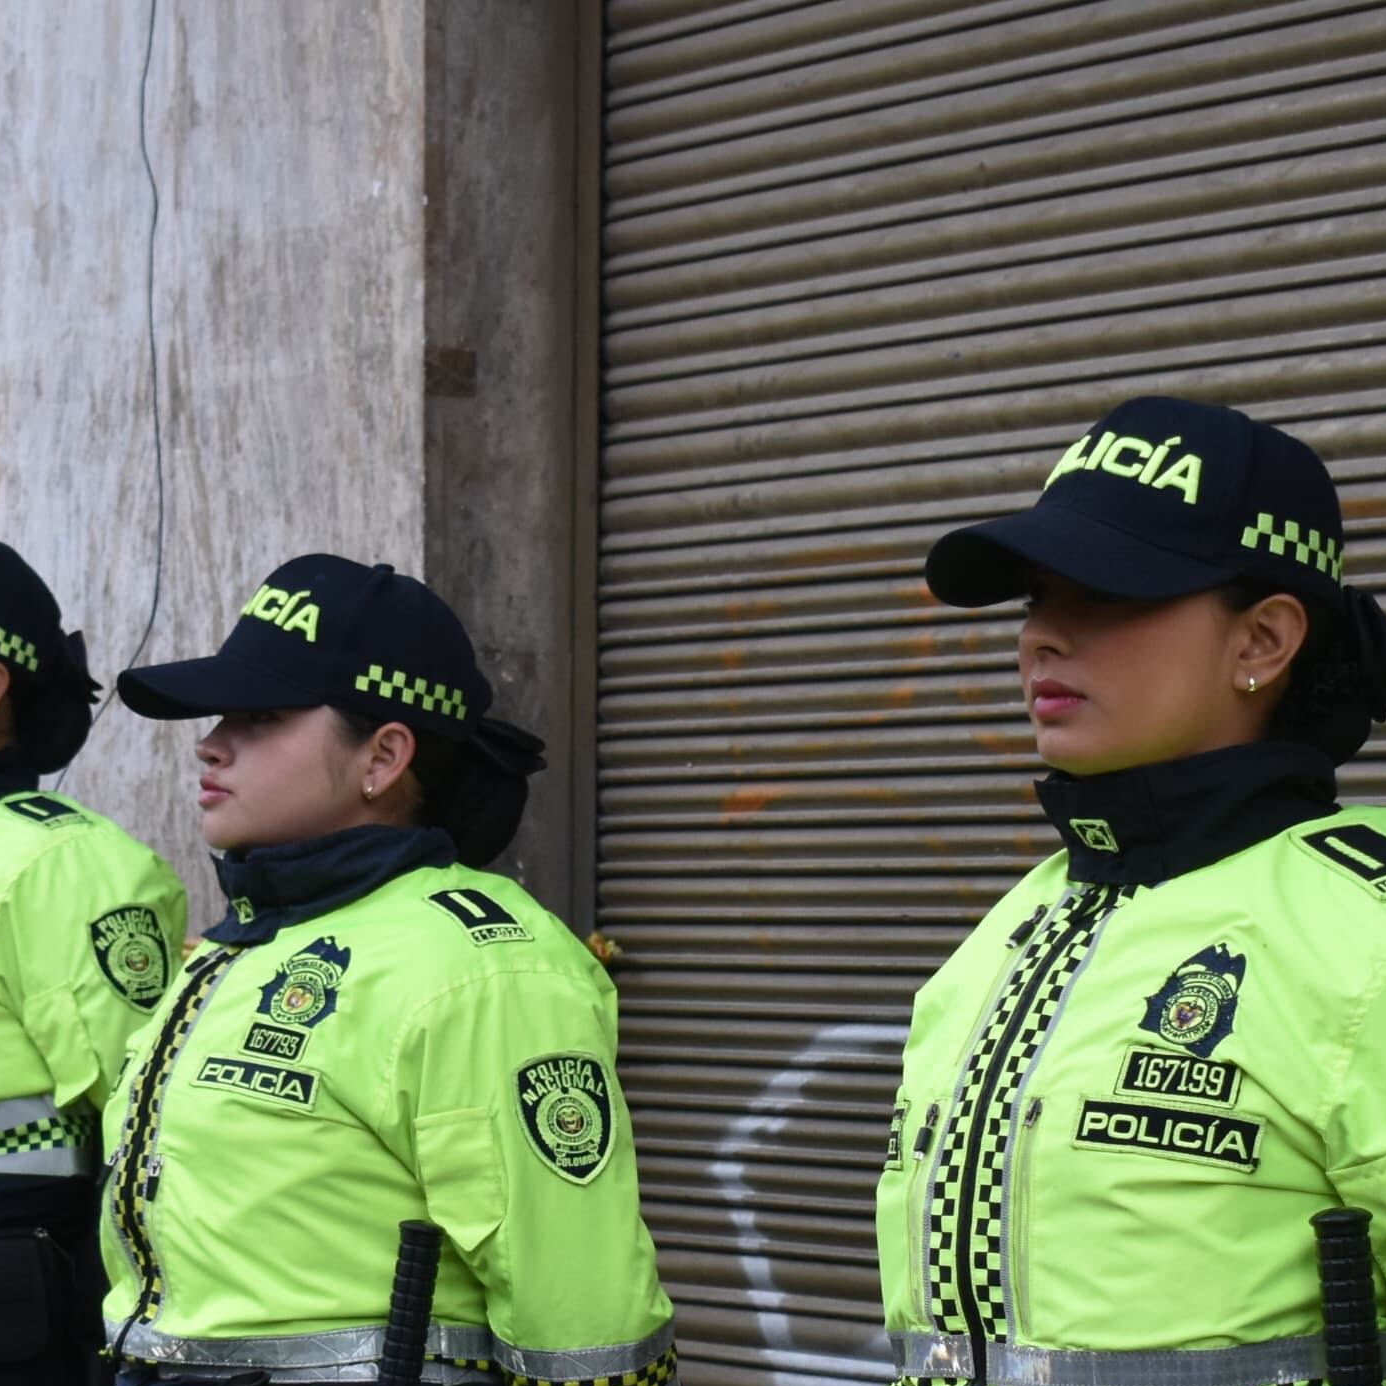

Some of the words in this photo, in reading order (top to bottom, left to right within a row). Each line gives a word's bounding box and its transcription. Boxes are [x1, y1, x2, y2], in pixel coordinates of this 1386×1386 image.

[1044, 431, 1202, 505] LICÍA
[241, 584, 320, 643] ICÍA
[248, 1028, 300, 1057] 167793
[199, 1062, 305, 1101] POLICÍA
[522, 1074, 604, 1107] NACIONAL
[1133, 1056, 1226, 1097] 167199
[1080, 1111, 1249, 1160] POLICÍA
